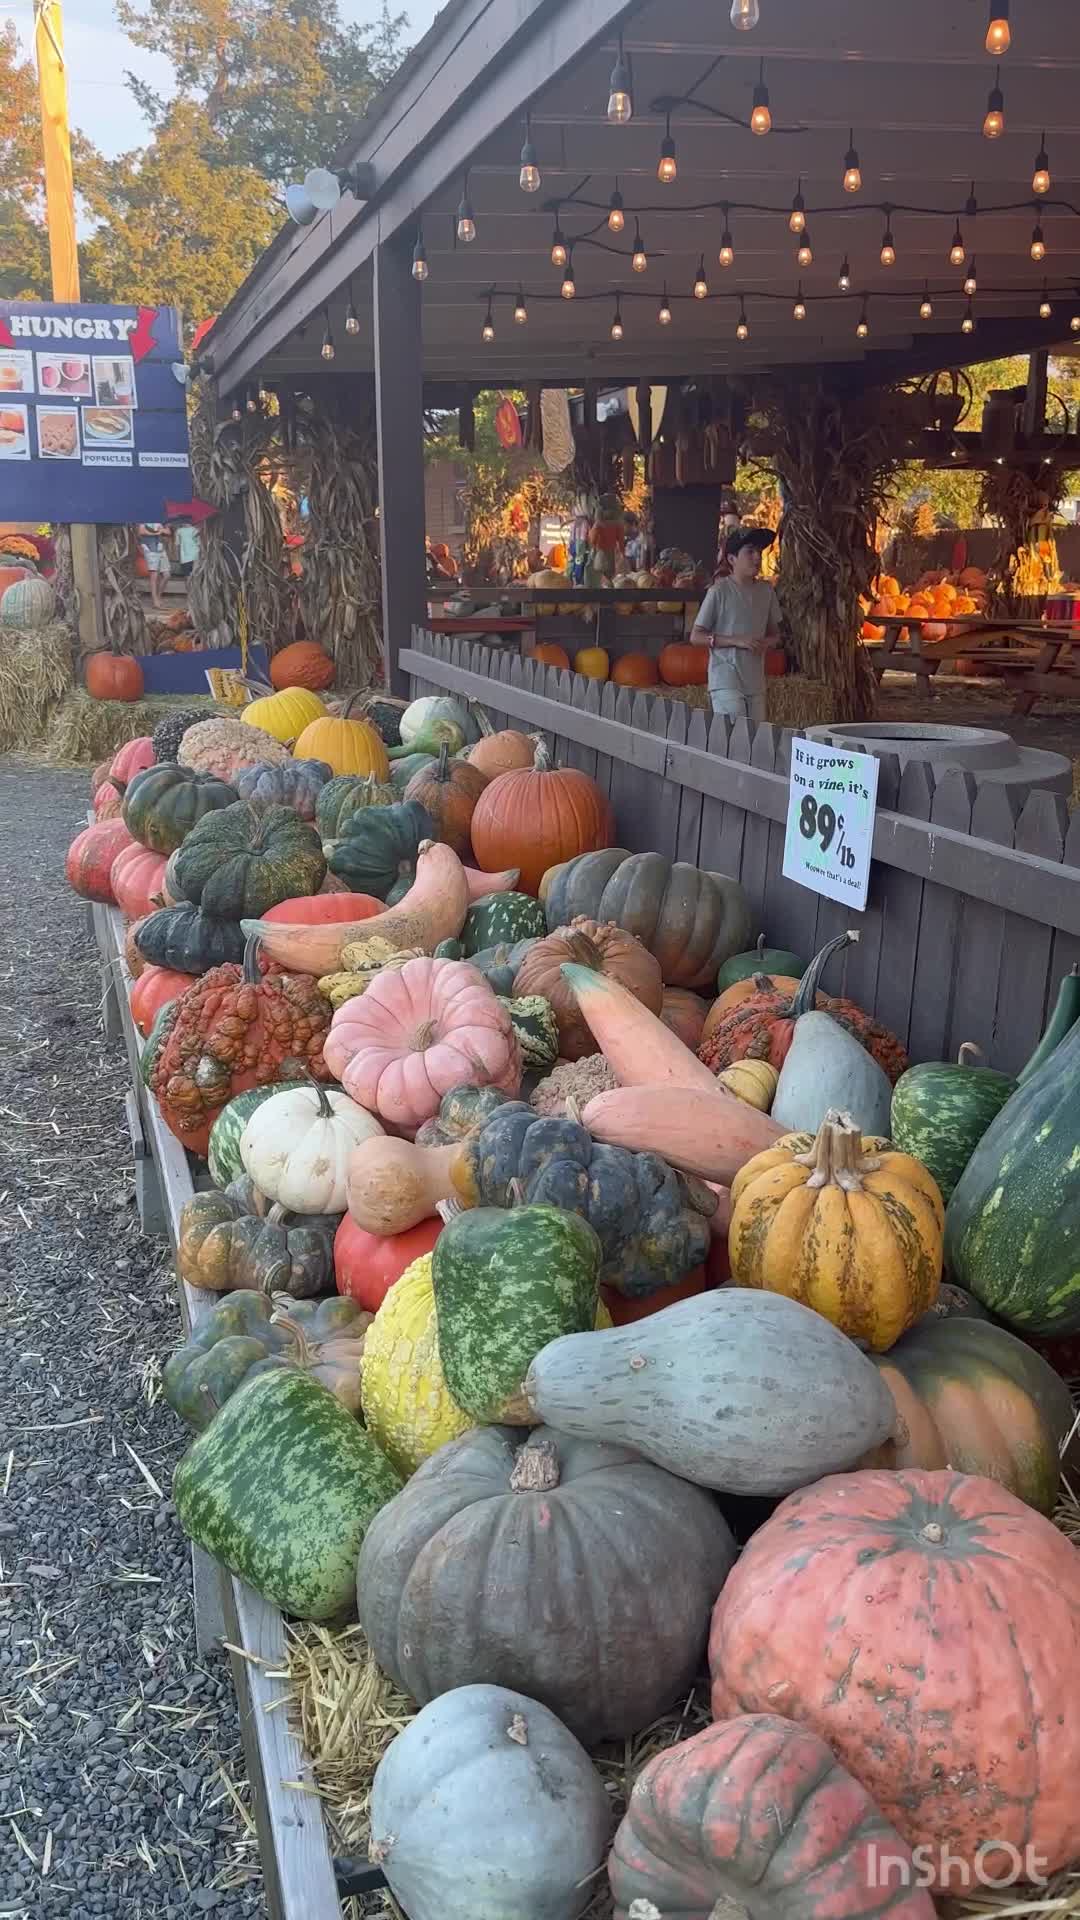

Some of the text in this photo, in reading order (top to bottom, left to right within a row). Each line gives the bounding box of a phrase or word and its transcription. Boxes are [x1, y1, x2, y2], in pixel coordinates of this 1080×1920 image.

[9, 315, 137, 340] HUNGRY
[84, 455, 131, 463] POPSICLES
[795, 748, 854, 770] If it grows
[794, 773, 869, 800] on a vine, it's
[826, 870, 842, 883] that's
